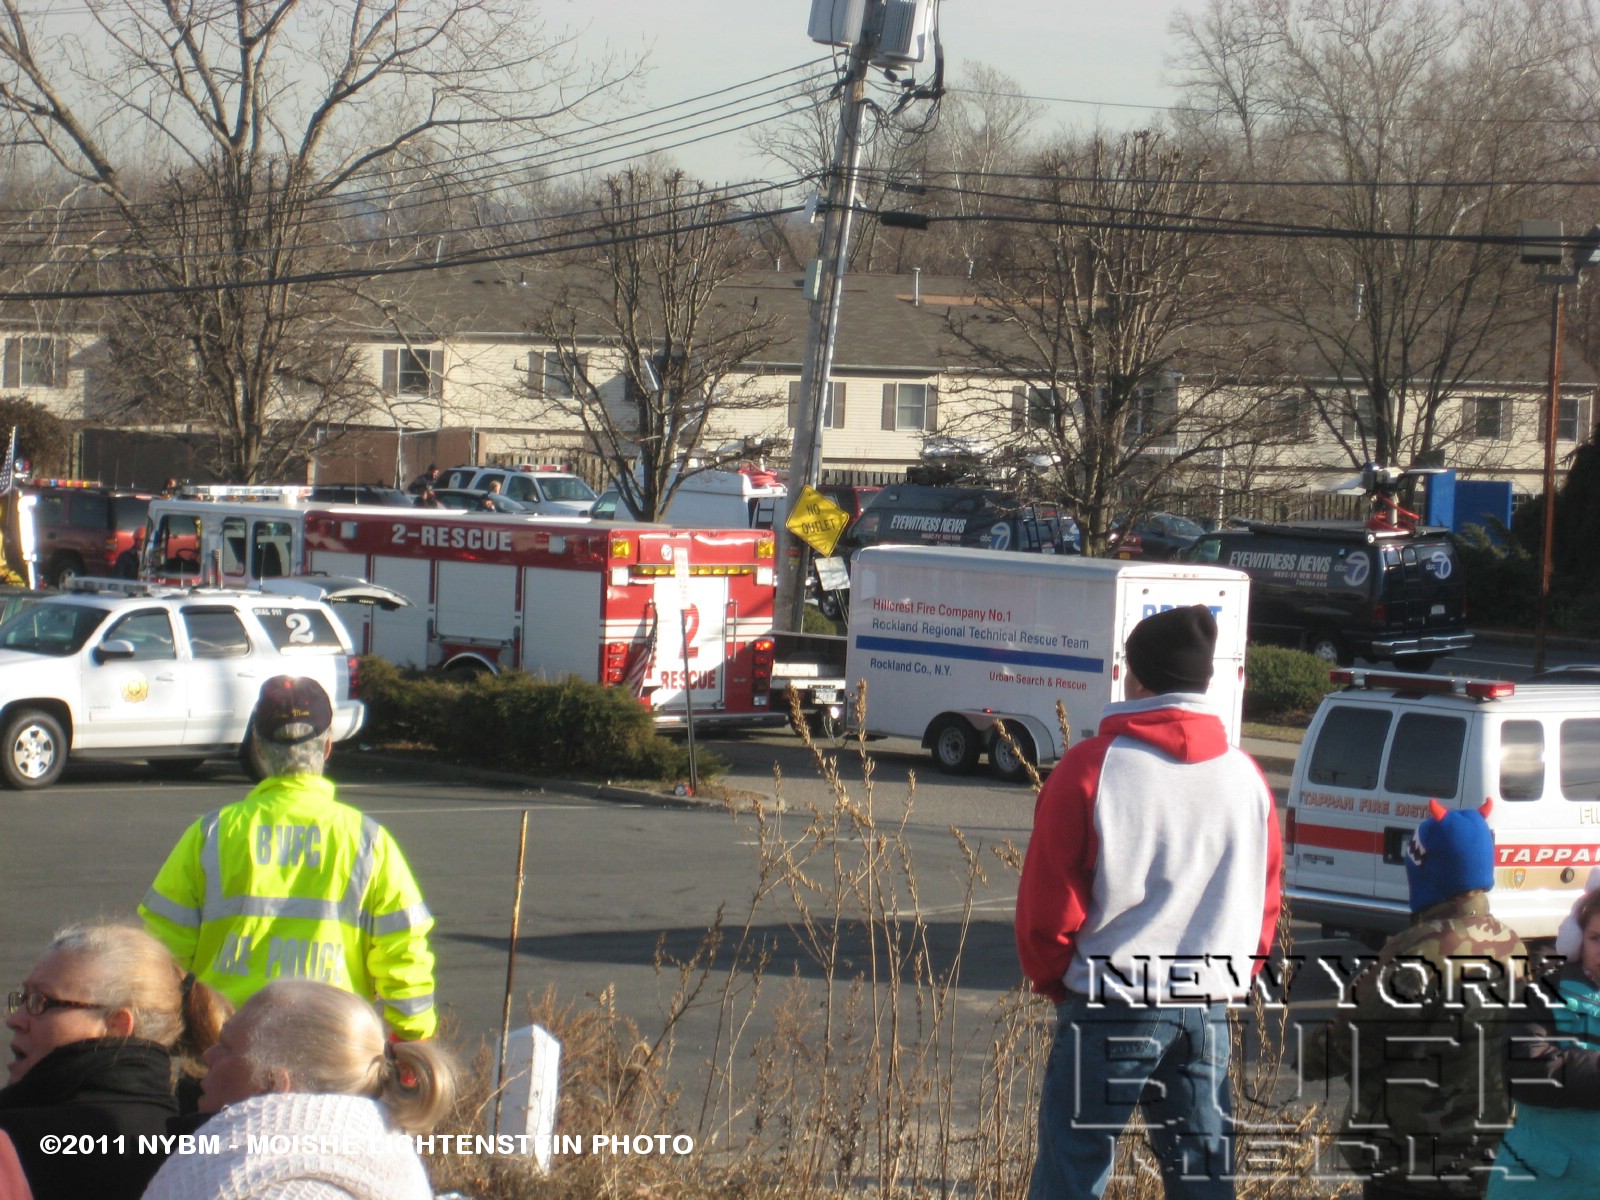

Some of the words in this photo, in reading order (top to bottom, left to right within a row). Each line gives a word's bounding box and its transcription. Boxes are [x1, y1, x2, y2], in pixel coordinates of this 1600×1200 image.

[806, 504, 820, 515] NO
[802, 519, 835, 534] OUTLET
[891, 515, 939, 532] EYEWITNESS
[940, 518, 967, 534] NEWS
[391, 523, 512, 551] 2-RESCUE
[1229, 551, 1297, 570] EYEWITNESS
[1297, 555, 1332, 572] NEWS
[1334, 563, 1348, 572] abc
[873, 599, 914, 614] Hillcrest
[916, 602, 936, 615] Fire
[938, 604, 986, 622] Company
[285, 613, 314, 644] 2
[679, 603, 700, 659] 2
[872, 618, 918, 633] Rockland
[922, 622, 965, 638] Regional
[969, 626, 1017, 643] Technical
[1020, 631, 1058, 647] Rescue
[1061, 635, 1089, 649] Team
[870, 658, 912, 672] Rockland
[660, 669, 716, 690] RESCUE
[989, 671, 1014, 683] Urban
[1016, 673, 1044, 686] Search
[1047, 677, 1053, 687] &
[1055, 677, 1087, 691] Rescue
[1302, 791, 1354, 811] TAPPAN
[1359, 799, 1390, 814] FIRE
